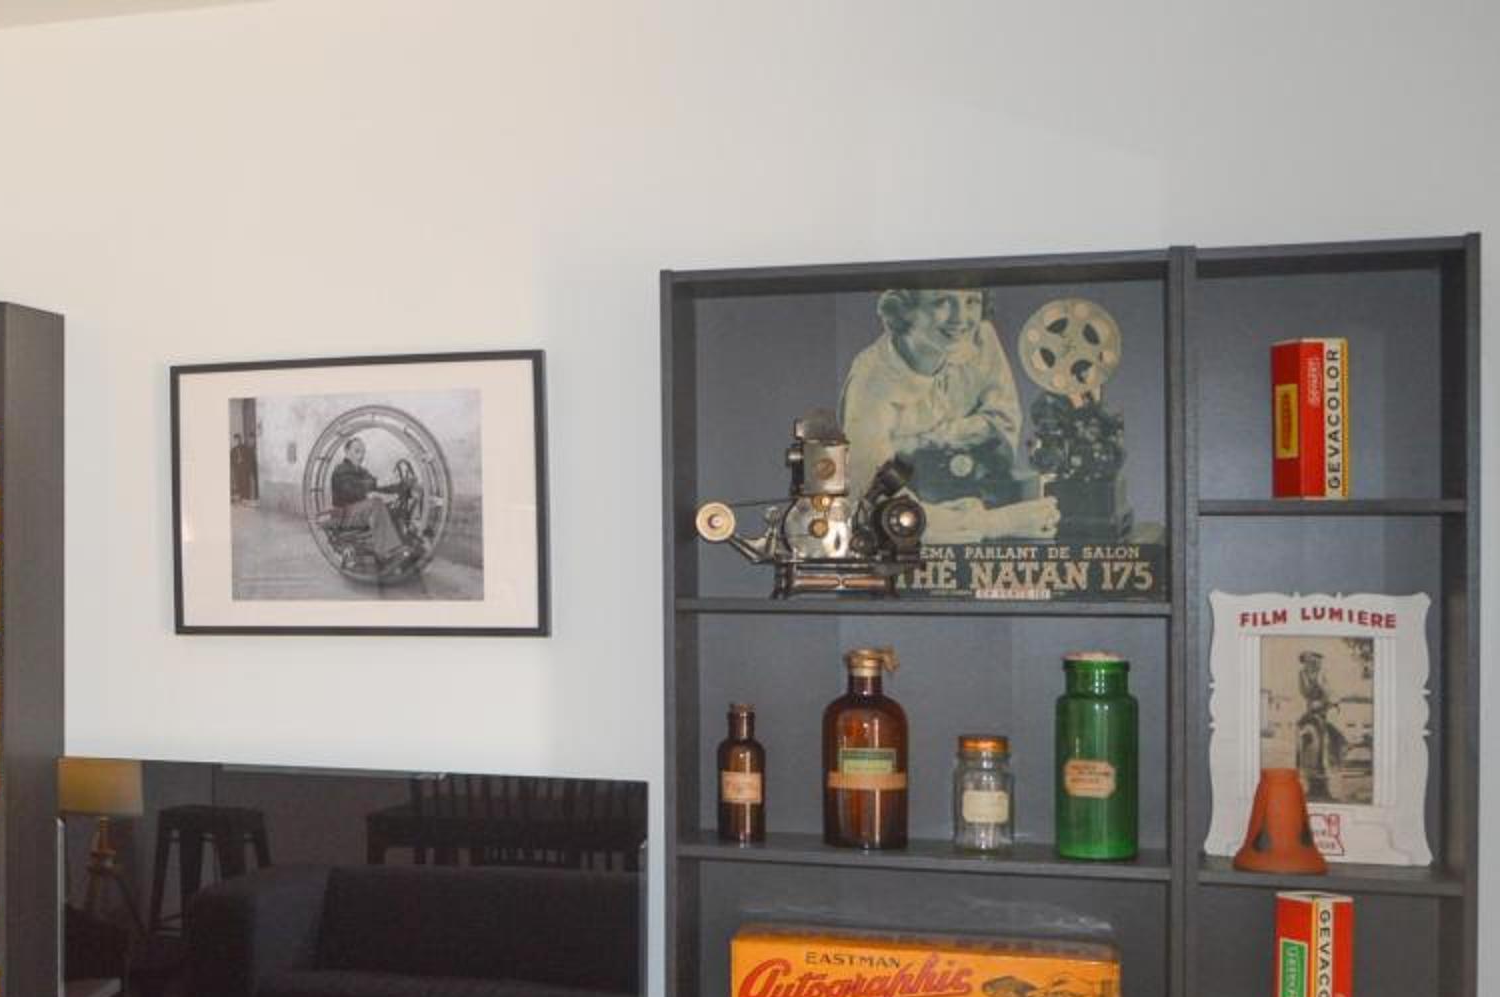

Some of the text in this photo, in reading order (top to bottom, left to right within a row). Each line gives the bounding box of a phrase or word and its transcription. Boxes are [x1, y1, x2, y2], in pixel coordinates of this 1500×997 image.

[1325, 349, 1341, 489] GEVACOLOR
[964, 546, 1038, 560] PARLANT
[1047, 547, 1071, 560] DE
[1082, 547, 1141, 560] SALON
[969, 560, 1090, 591] NATAN
[1100, 561, 1155, 591] 175
[1239, 609, 1288, 628] FILM
[804, 951, 900, 968] EASTMAN
